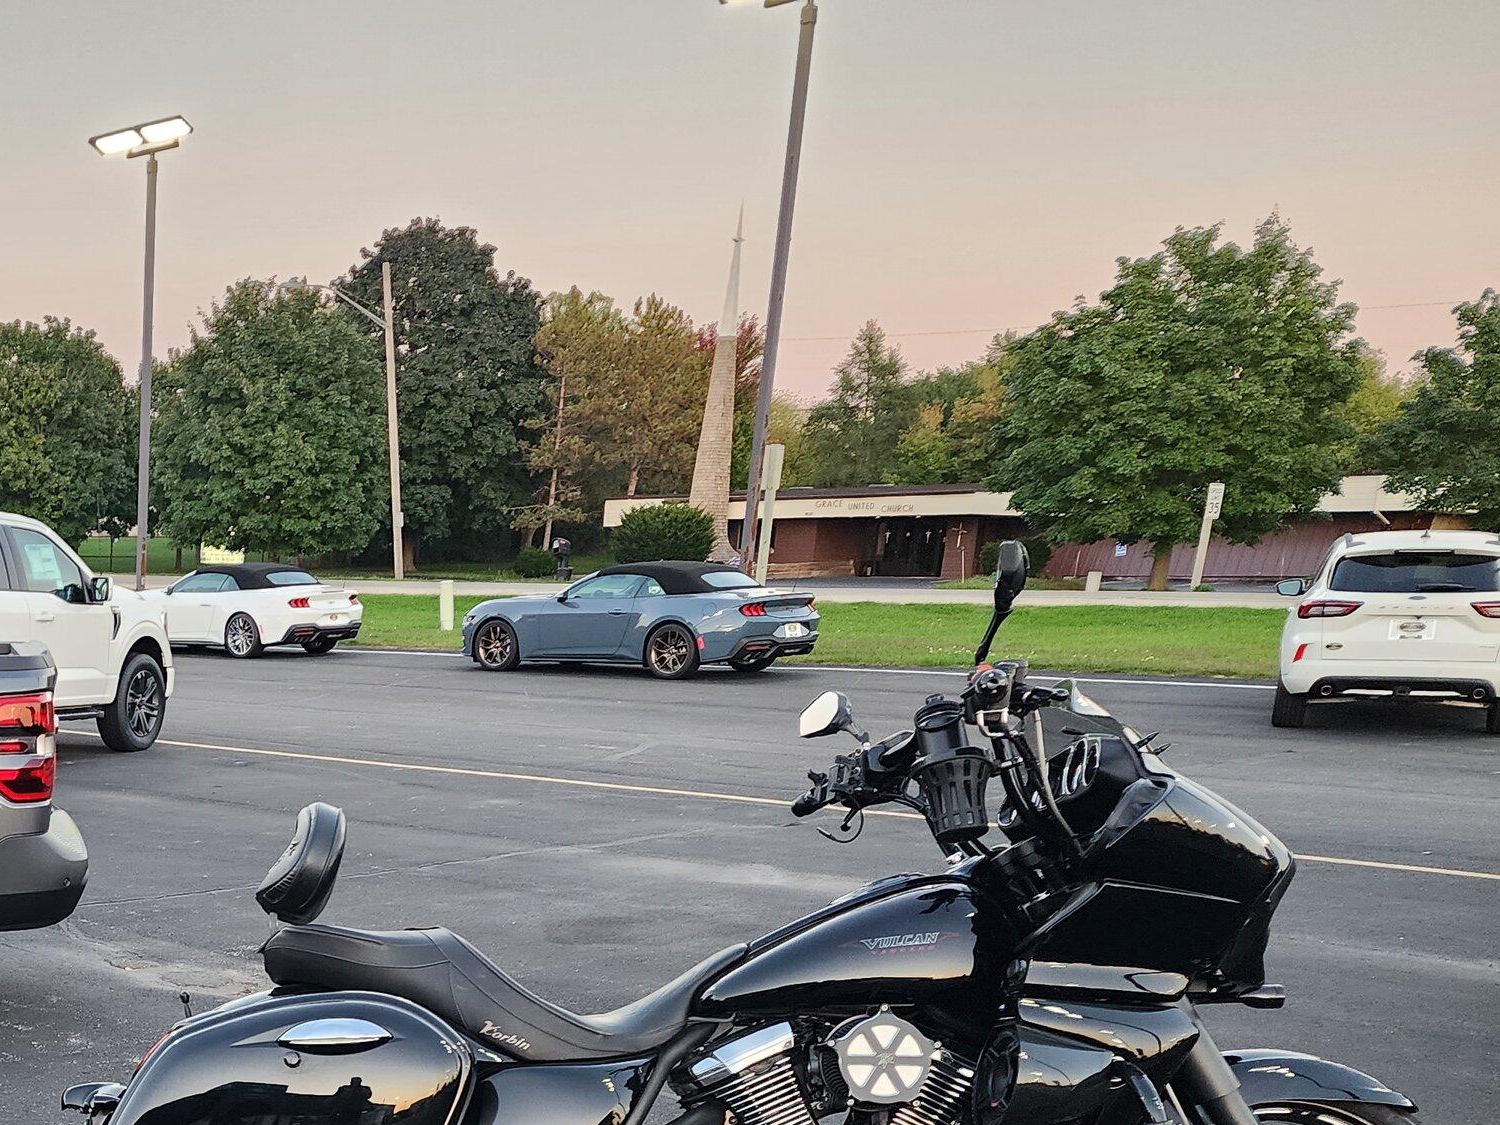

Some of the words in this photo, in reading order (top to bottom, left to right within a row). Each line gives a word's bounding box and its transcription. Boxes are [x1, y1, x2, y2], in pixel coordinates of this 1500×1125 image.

[815, 500, 843, 508] GRACE
[847, 502, 875, 510] UNITED
[881, 504, 914, 512] CHURCH
[1209, 502, 1220, 513] 35
[860, 932, 940, 950] VULCAN
